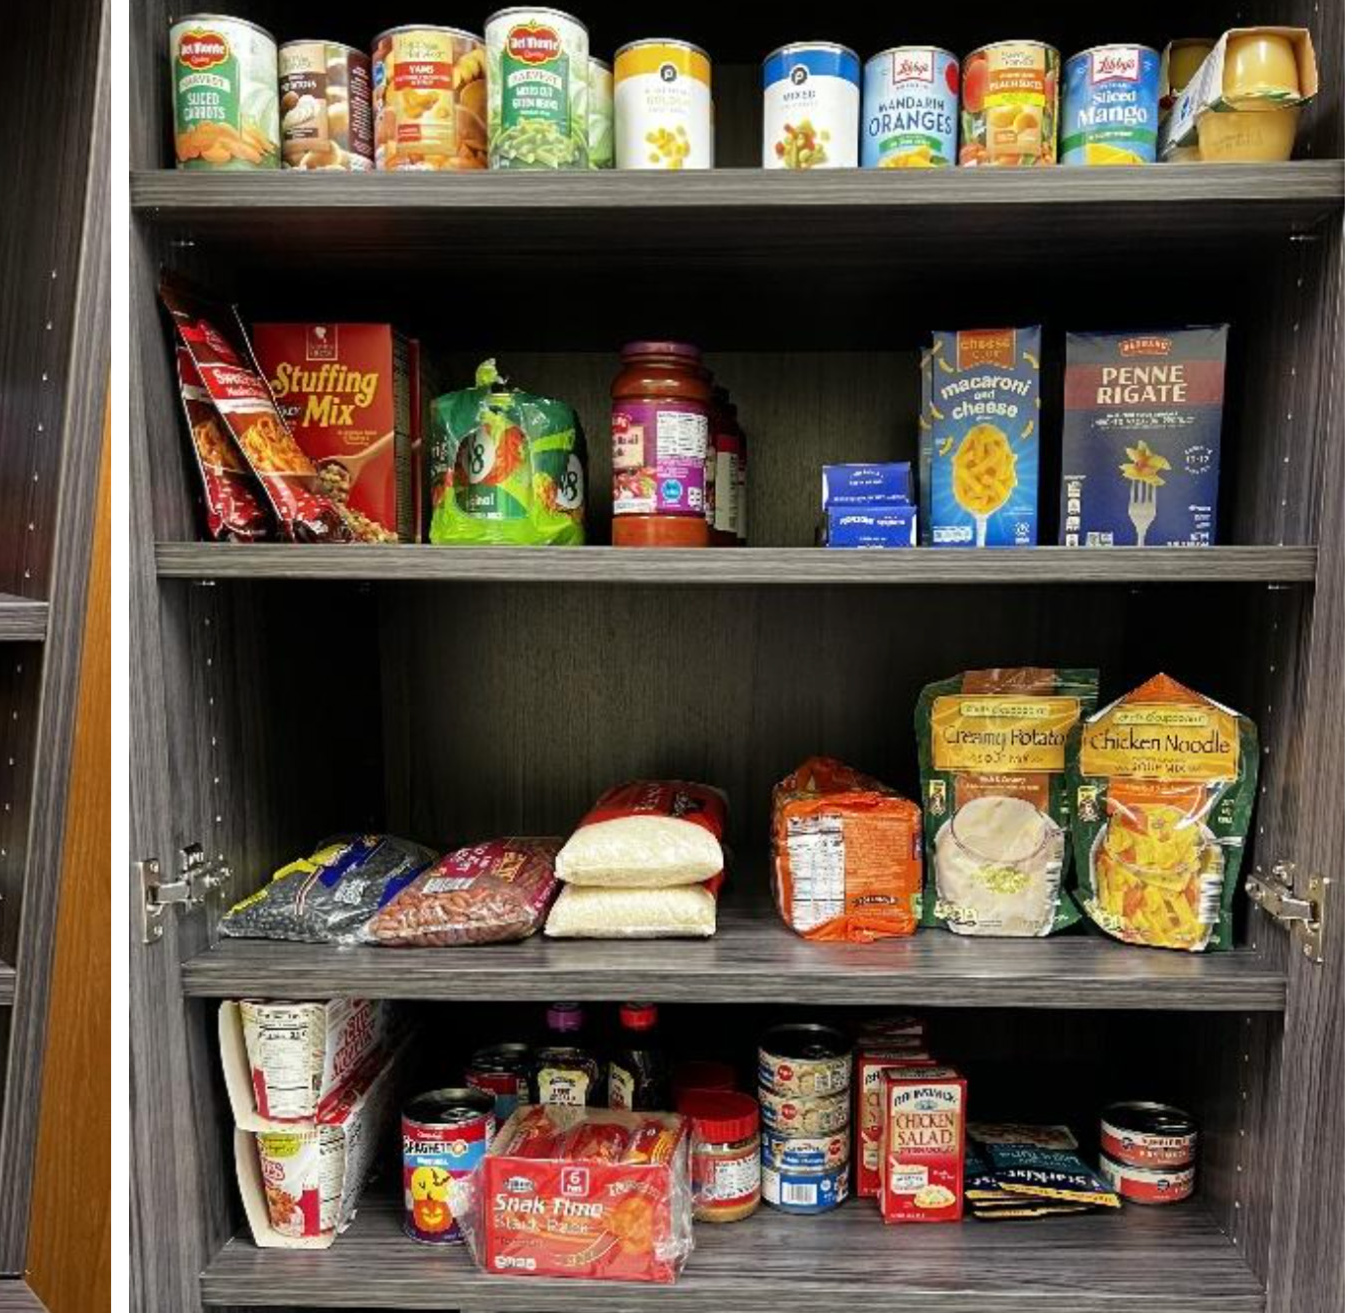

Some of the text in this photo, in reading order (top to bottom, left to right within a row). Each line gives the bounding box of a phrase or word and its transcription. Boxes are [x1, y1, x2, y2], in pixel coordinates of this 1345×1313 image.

[187, 92, 220, 105] SLICED
[879, 96, 944, 111] MANDARIN
[184, 107, 226, 121] CARROTS
[869, 111, 952, 136] ORANGES
[1078, 105, 1147, 128] Mango
[272, 362, 378, 408] Stuffing
[1102, 365, 1184, 385] PENNE
[941, 375, 1032, 400] macaroni
[1096, 384, 1187, 405] RIGATE
[303, 395, 354, 428] Mix
[952, 401, 1018, 420] cheese
[944, 725, 1067, 754] Creamy Potato
[1091, 728, 1230, 754] Chicken Noodle
[896, 1112, 954, 1129] CHICKEN
[898, 1130, 953, 1145] SALAD
[570, 1171, 580, 1184] 6
[494, 1193, 603, 1218] Snak Time
